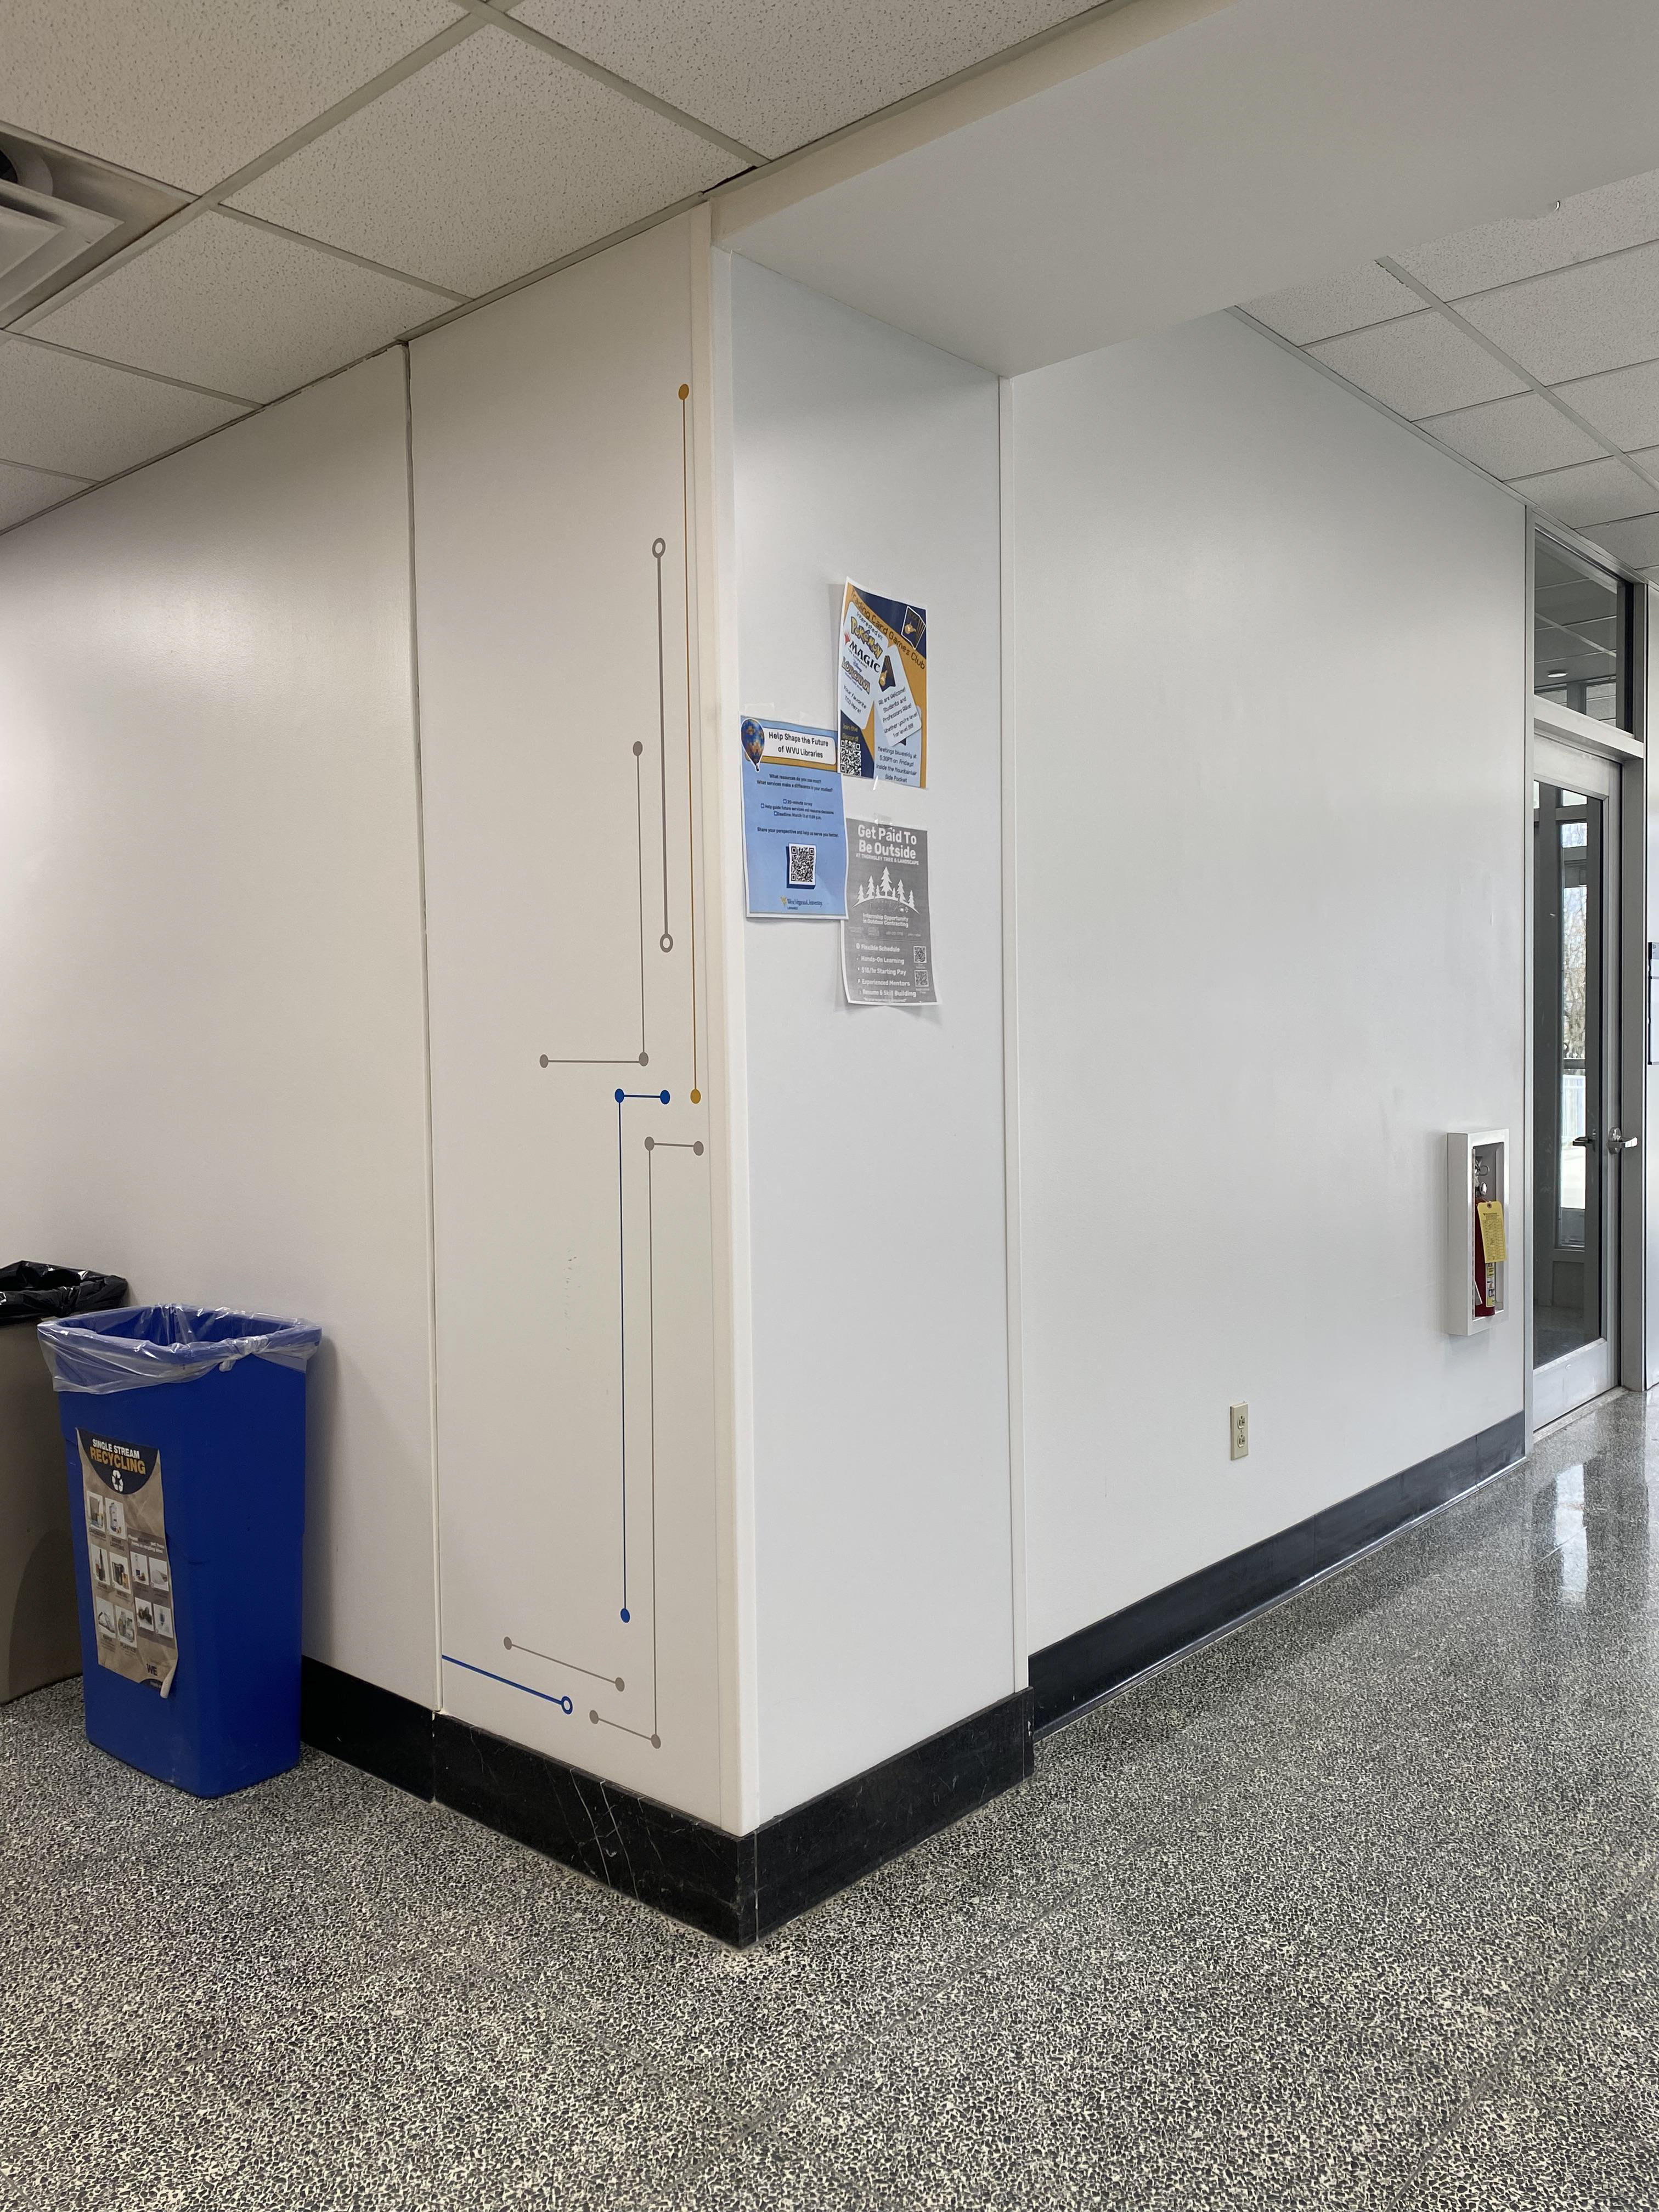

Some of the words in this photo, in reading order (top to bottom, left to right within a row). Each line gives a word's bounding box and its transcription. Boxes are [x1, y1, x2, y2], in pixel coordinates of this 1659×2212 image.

[872, 615, 888, 635] Card
[911, 652, 925, 669] Club
[849, 641, 881, 673] MAGIC
[769, 731, 783, 741] Help
[785, 733, 800, 743] Shape
[811, 738, 828, 747] Future
[786, 746, 799, 754] WVU
[800, 748, 823, 758] Libraries
[858, 825, 876, 839] Get
[878, 827, 902, 843] Paid
[904, 831, 917, 845] To
[859, 839, 872, 854] Be
[874, 842, 916, 859] Outside
[884, 920, 909, 928] Contracting
[877, 968, 896, 976] Starting
[92, 1438, 112, 1452] SINGLE
[113, 1445, 140, 1459] STREAM
[89, 1446, 146, 1475] RECYCLING
